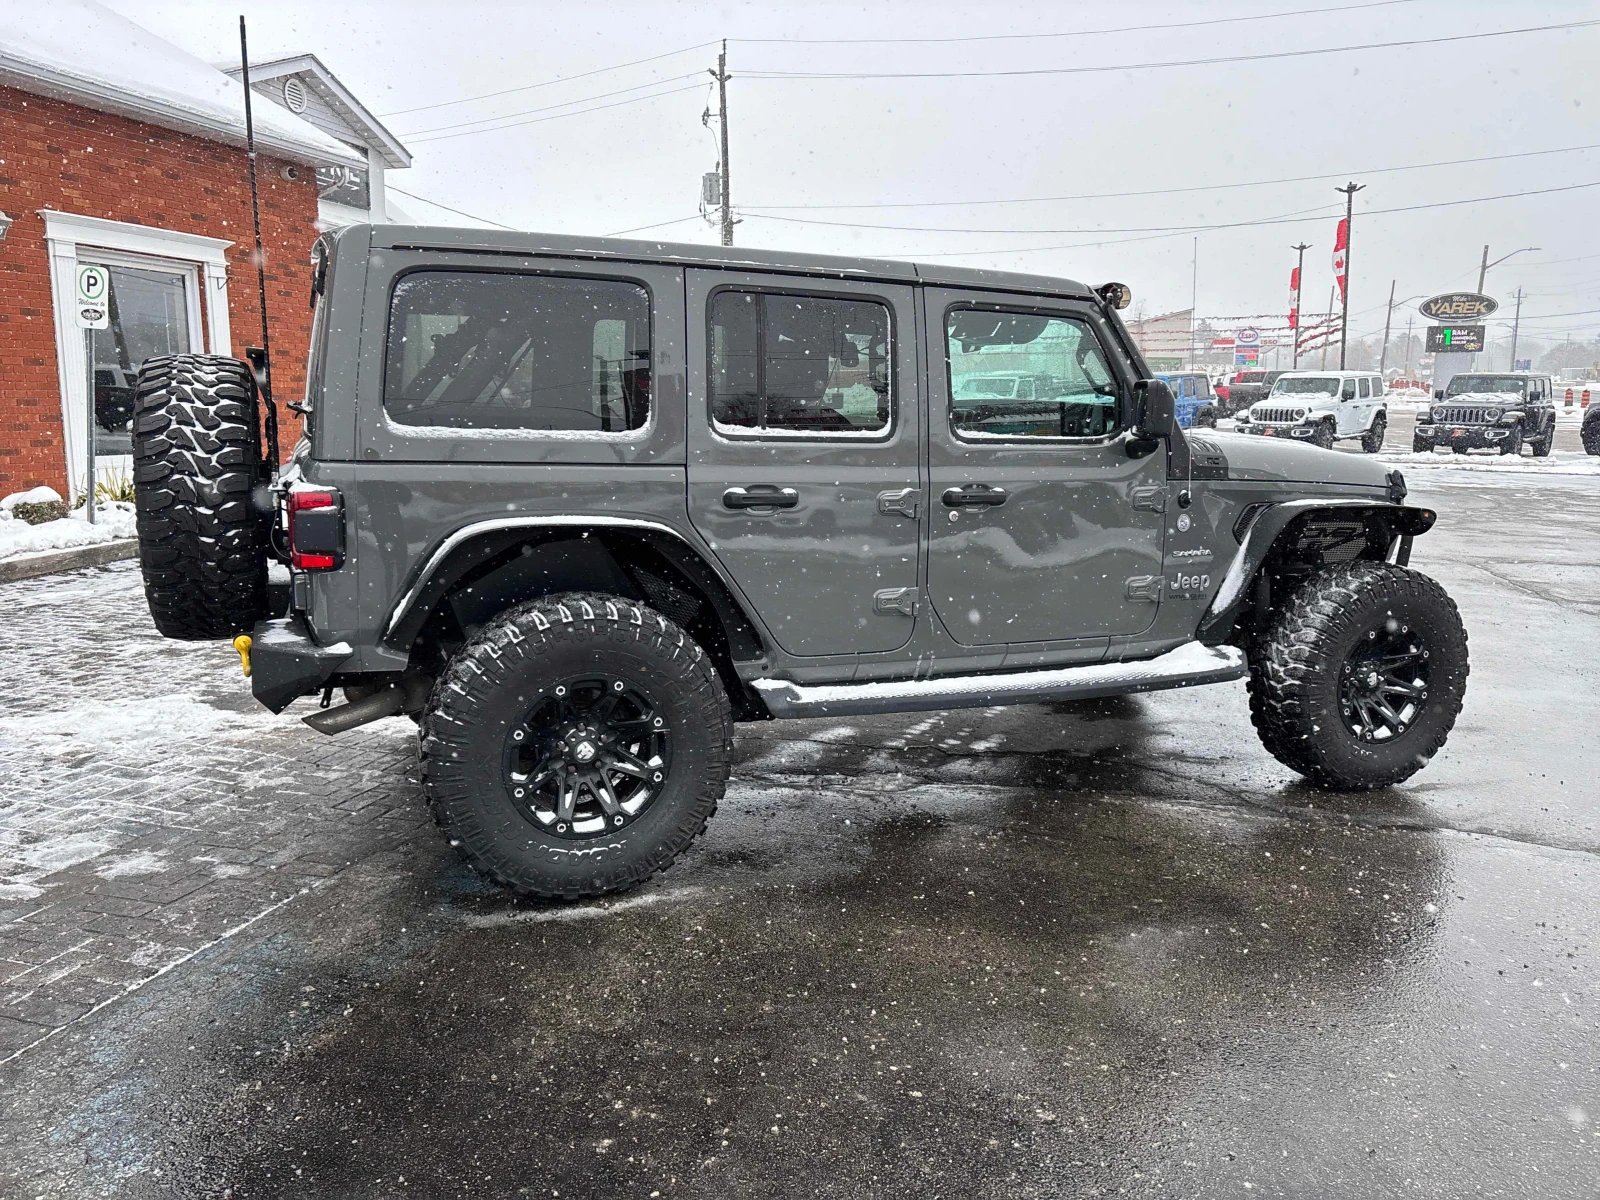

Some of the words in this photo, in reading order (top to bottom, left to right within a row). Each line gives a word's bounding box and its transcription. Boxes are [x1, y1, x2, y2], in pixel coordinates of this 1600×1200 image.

[87, 275, 97, 293] P
[78, 298, 99, 307] Welcome
[1430, 302, 1488, 314] YAREK
[1172, 549, 1212, 557] SAHARA
[1170, 573, 1210, 591] Jeep
